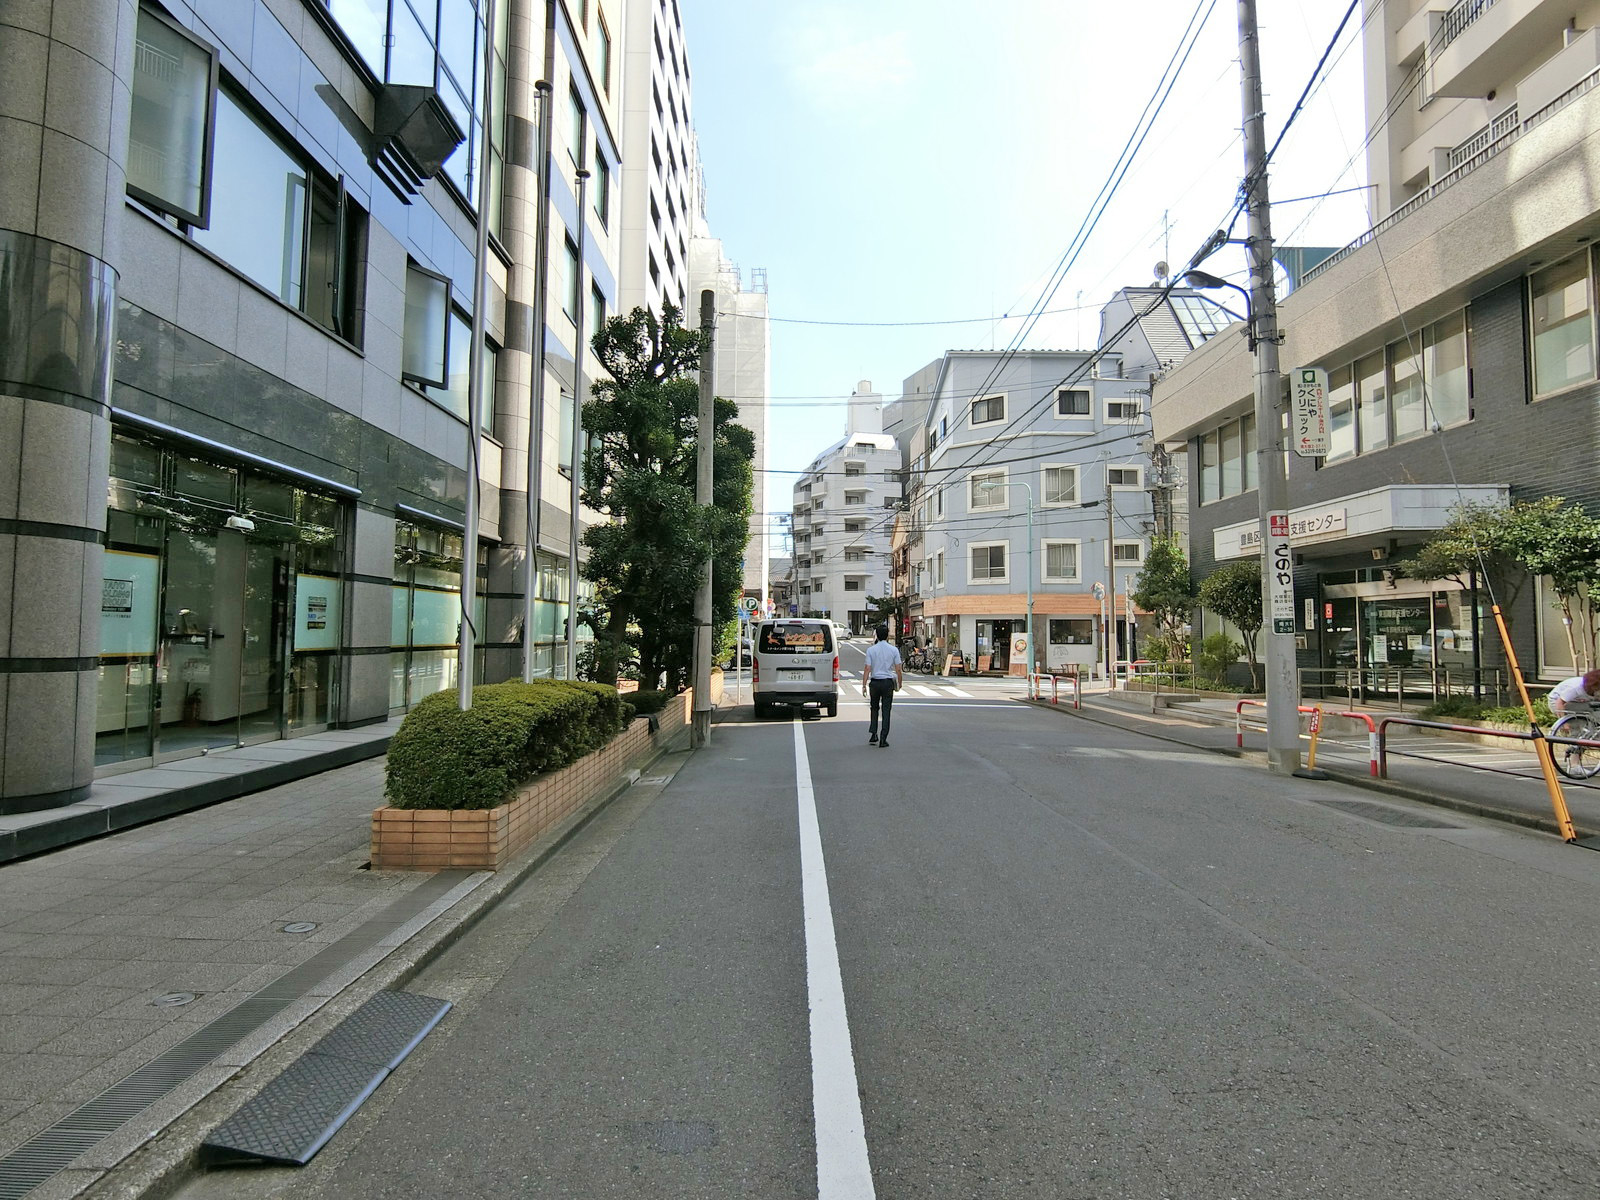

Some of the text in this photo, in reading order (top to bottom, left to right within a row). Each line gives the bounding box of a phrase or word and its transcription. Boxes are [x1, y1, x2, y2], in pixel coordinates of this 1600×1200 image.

[1297, 388, 1309, 435] クリニック
[1307, 388, 1318, 418] くにや
[1241, 515, 1342, 546] 豊島区 支援センター
[1274, 543, 1291, 586] さのや
